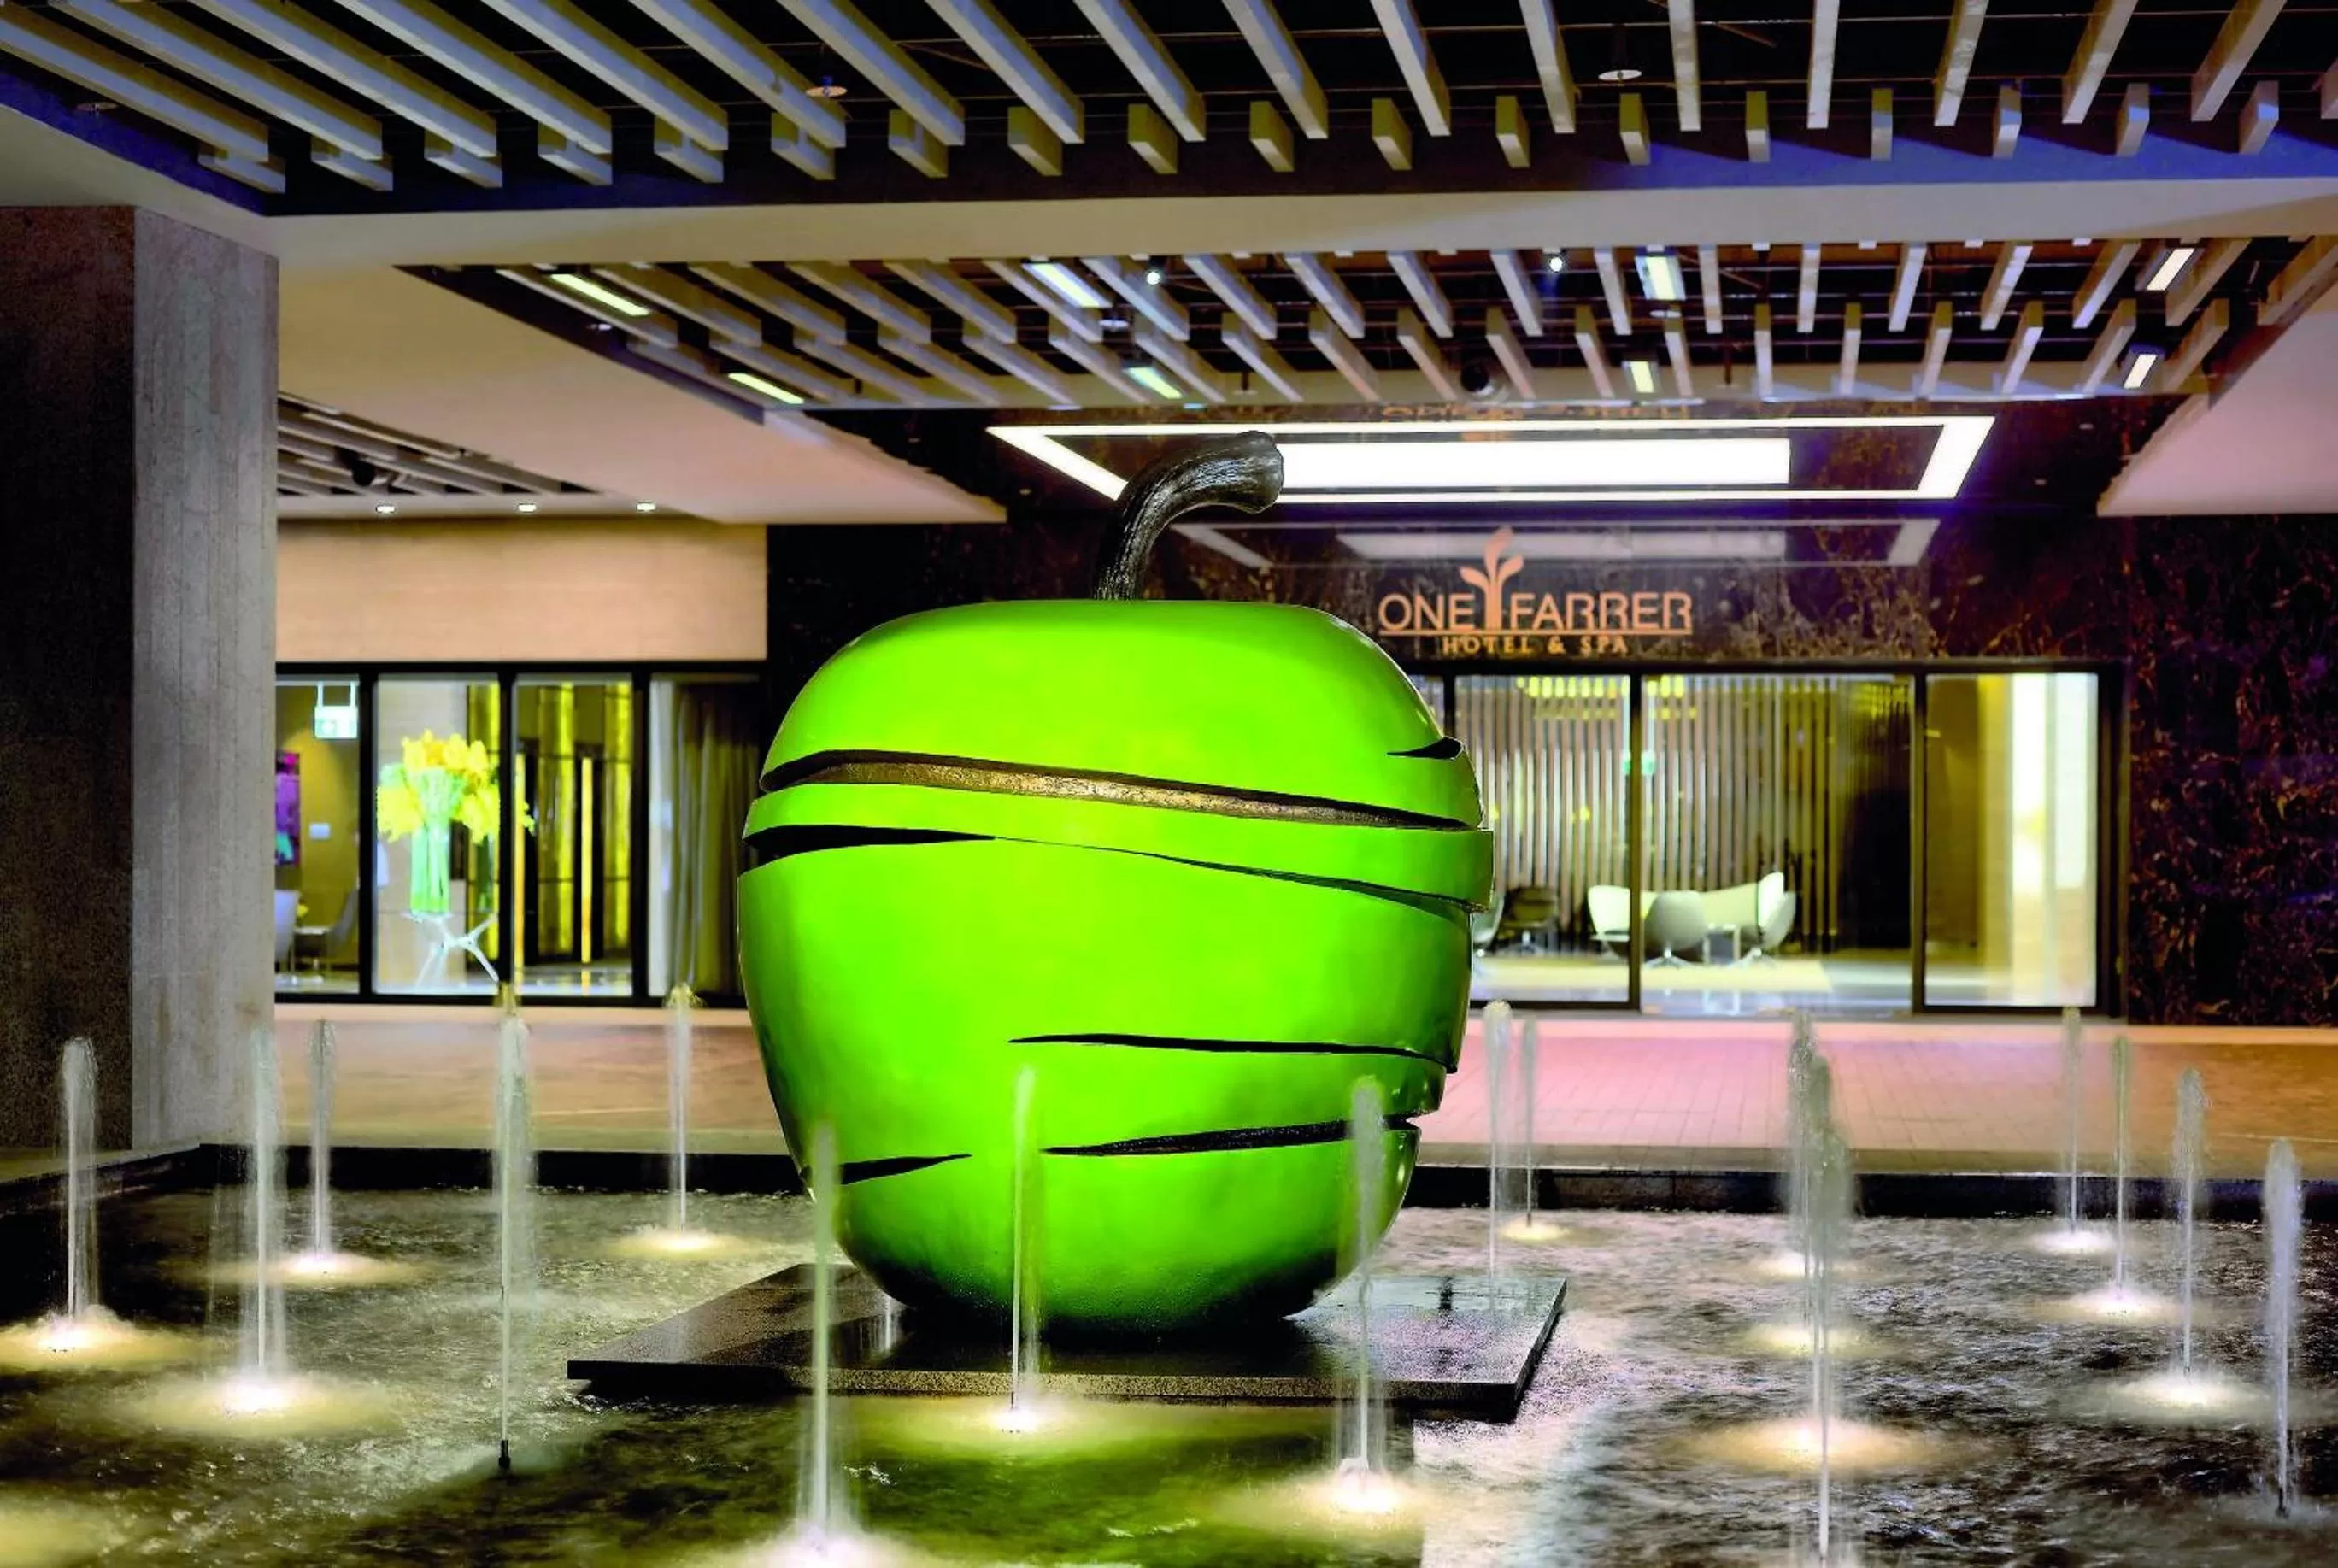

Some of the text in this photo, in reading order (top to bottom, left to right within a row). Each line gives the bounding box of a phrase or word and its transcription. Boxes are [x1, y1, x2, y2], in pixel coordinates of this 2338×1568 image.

[1378, 592, 1693, 631] ONE FARRER
[1442, 635, 1629, 656] HOTEL & SPA
